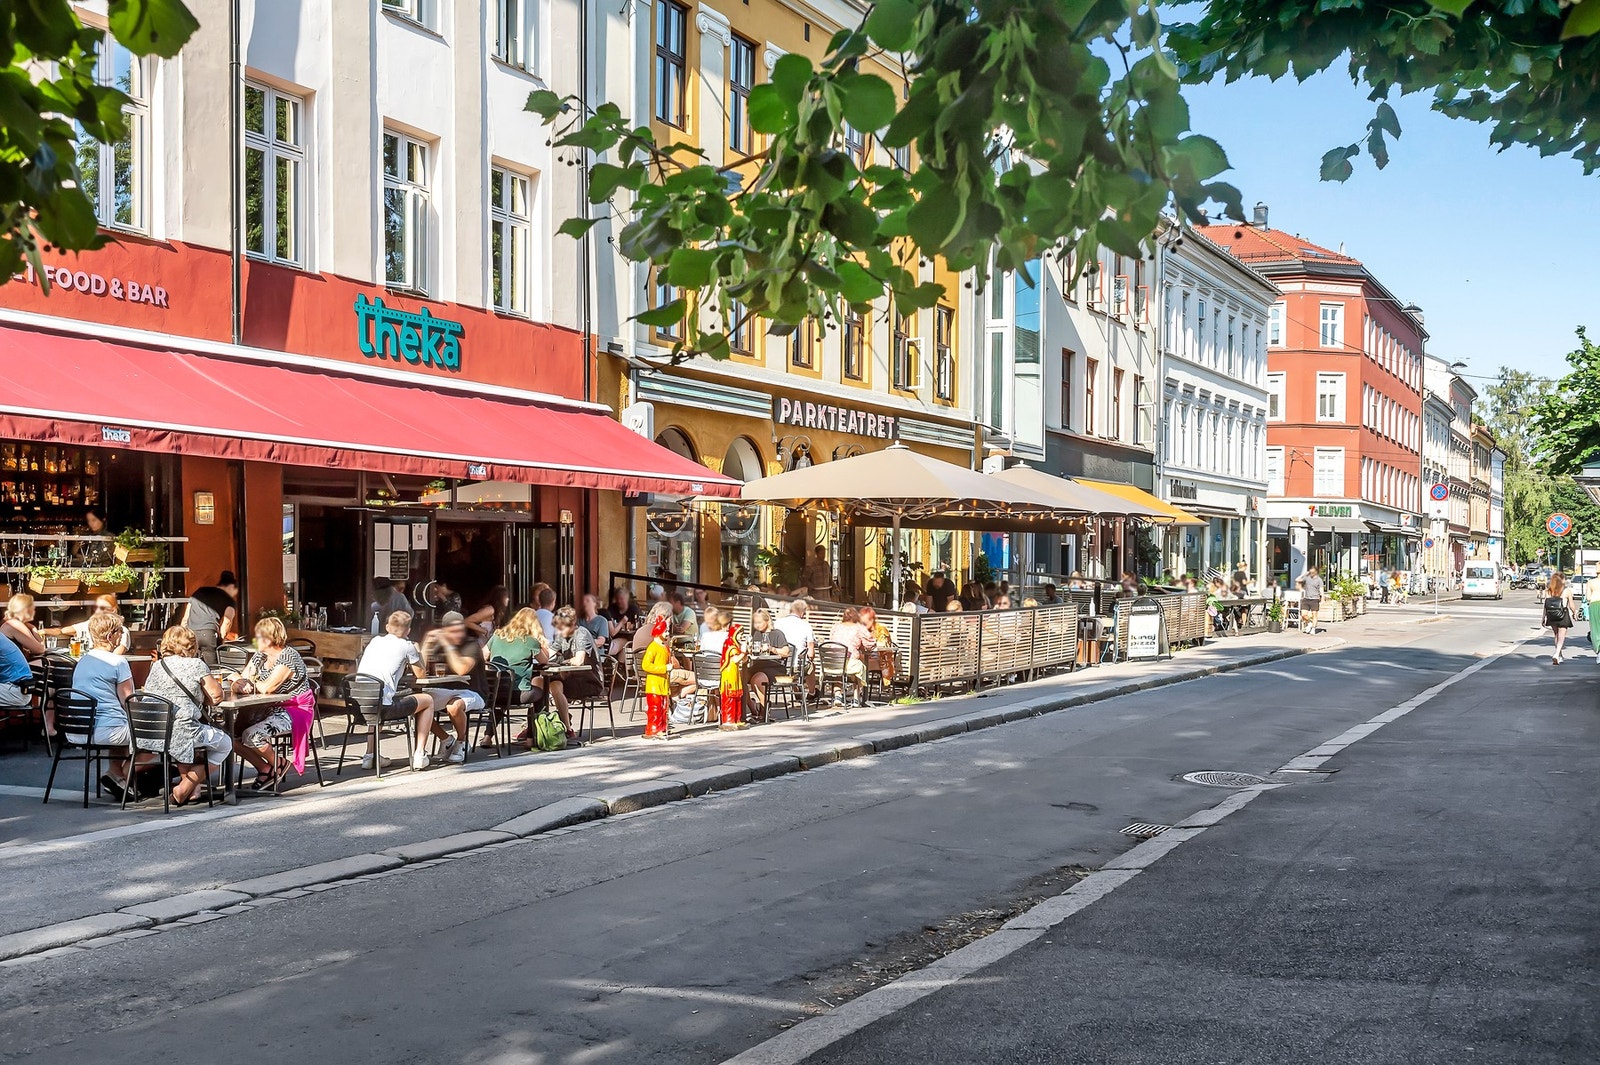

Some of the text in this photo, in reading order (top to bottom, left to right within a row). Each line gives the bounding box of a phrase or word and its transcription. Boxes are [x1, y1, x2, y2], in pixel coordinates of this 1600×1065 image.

[43, 264, 106, 294] FOOD
[110, 277, 124, 299] &
[127, 280, 168, 307] BAR
[353, 292, 463, 368] theka
[779, 397, 895, 440] PARKTEATRET
